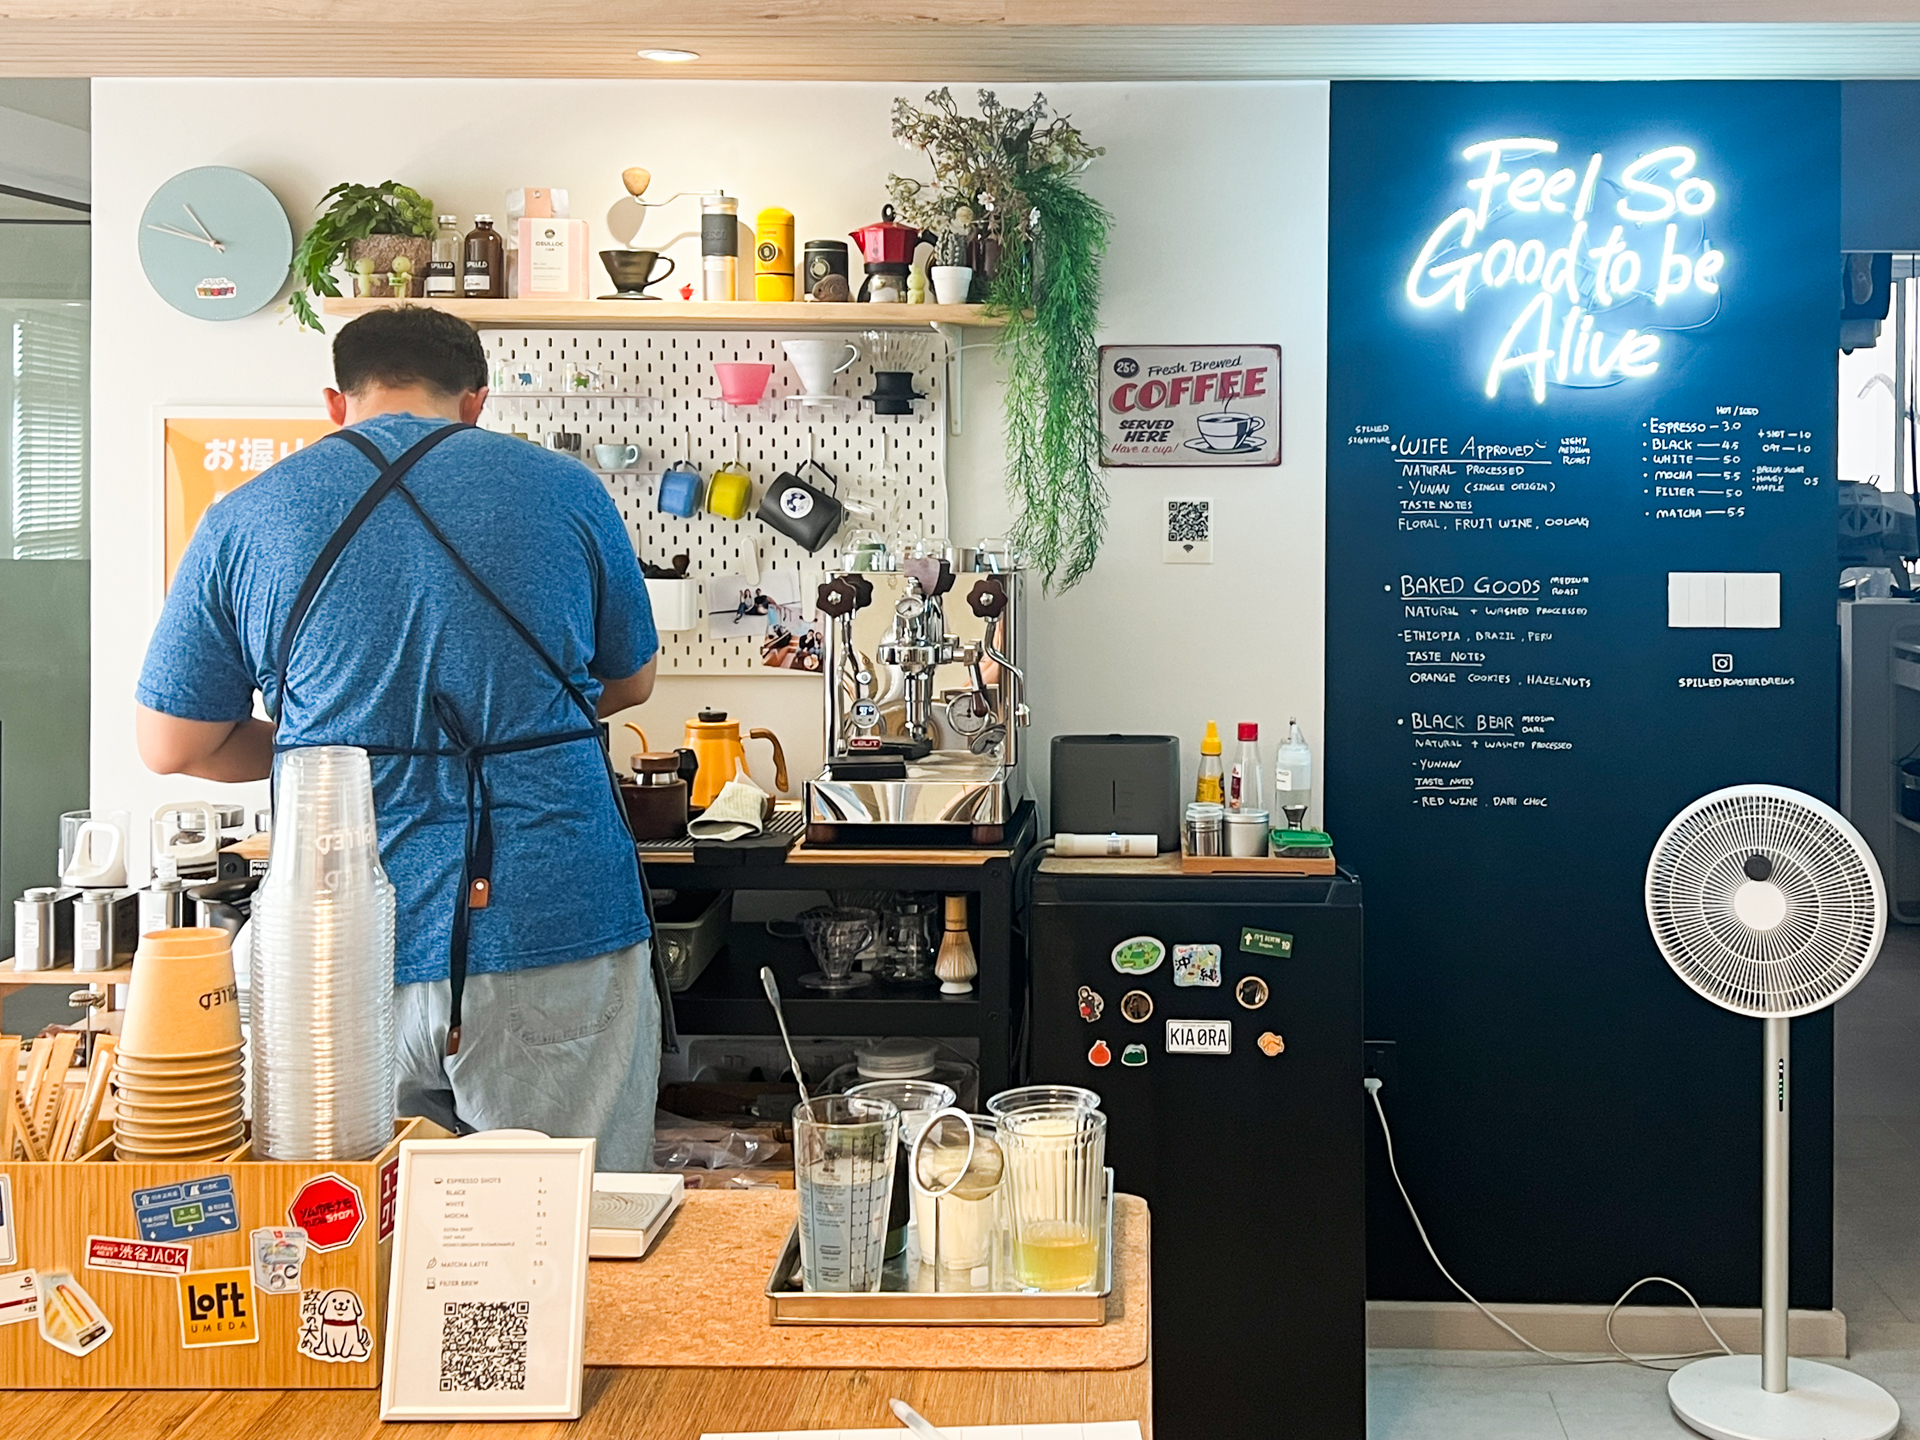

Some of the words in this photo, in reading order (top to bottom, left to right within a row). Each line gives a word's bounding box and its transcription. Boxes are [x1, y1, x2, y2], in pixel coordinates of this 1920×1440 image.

[1462, 137, 1602, 230] Feel
[1616, 145, 1716, 222] So
[1406, 207, 1588, 311] Good
[1588, 224, 1641, 306] to
[1654, 222, 1725, 306] be
[1485, 291, 1661, 404] Alive
[1147, 364, 1187, 377] Fresh
[1190, 355, 1242, 372] Brewed
[1108, 366, 1269, 415] COFFEE
[1118, 420, 1174, 430] SERVED
[1650, 417, 1706, 434] ESPRESSO
[1123, 431, 1170, 442] HERE
[1111, 443, 1139, 453] Have
[1141, 445, 1150, 453] a
[1152, 443, 1179, 455] cup!
[1400, 435, 1449, 456] WIFE
[1460, 436, 1534, 459] APPROVED
[1652, 438, 1693, 451] BLACK
[1653, 454, 1693, 464] WHITE
[1402, 464, 1457, 476] NATURAL
[1466, 466, 1525, 476] PROCESSED
[1654, 470, 1693, 481] MOCHA
[1655, 486, 1696, 497] FILTER
[1400, 500, 1436, 510] TASTE
[1439, 500, 1473, 510] NOTES
[1656, 508, 1702, 519] MATCHA
[1455, 518, 1492, 529] FRUIT
[1545, 518, 1590, 528] OOLONG
[1400, 574, 1464, 597] BAKED
[1474, 576, 1541, 595] GOODS
[1551, 587, 1579, 596] ROAST
[1405, 606, 1459, 618] NATURAL
[1485, 606, 1530, 616] WASHED
[1527, 632, 1553, 641] PERU
[1406, 651, 1442, 662] TASTE
[1450, 651, 1486, 662] NOTES
[1409, 672, 1457, 684] ORANGE
[1526, 674, 1592, 689] HAZELNUTS
[1411, 712, 1465, 730] BLACK
[1476, 714, 1515, 732] BEAR
[1414, 739, 1463, 749] NATURAL
[1413, 777, 1444, 787] TASTE
[1449, 777, 1475, 787] NOTES
[1421, 796, 1445, 808] RED
[190, 1323, 247, 1334] UMEDA
